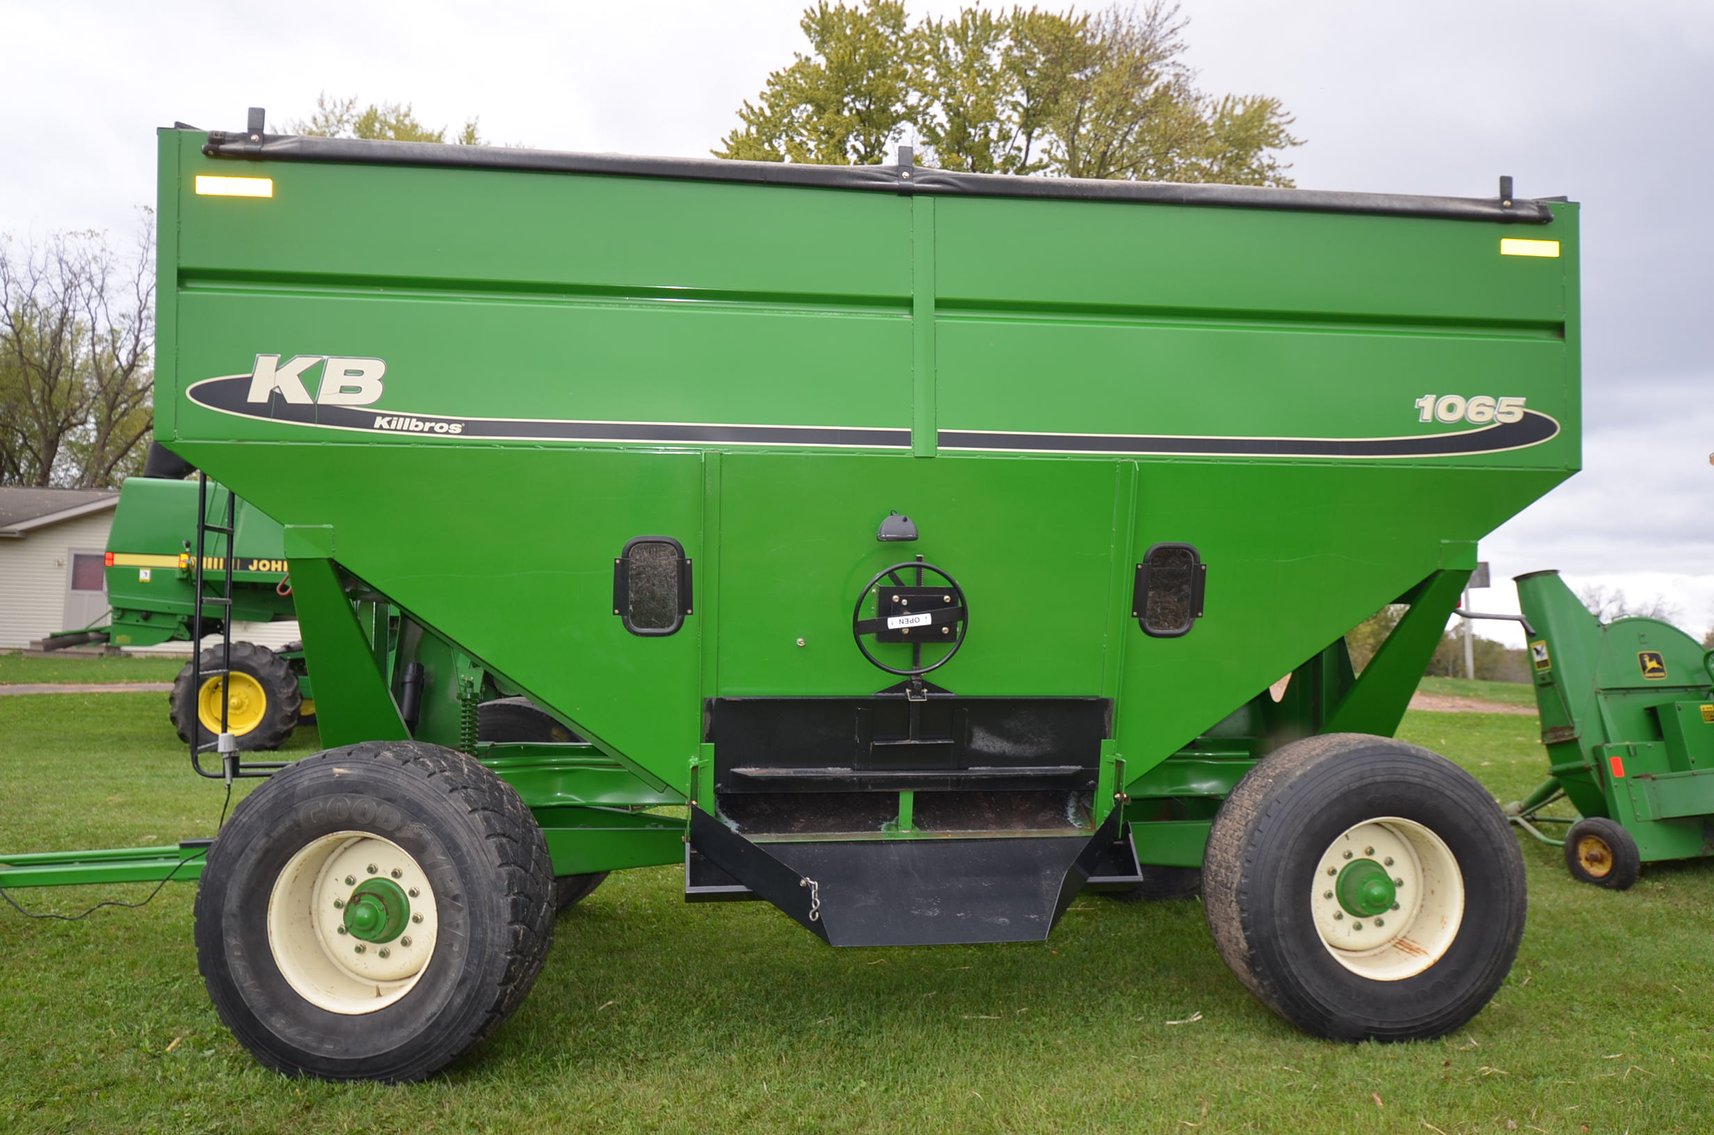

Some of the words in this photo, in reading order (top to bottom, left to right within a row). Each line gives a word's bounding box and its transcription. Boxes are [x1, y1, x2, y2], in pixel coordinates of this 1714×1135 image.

[247, 353, 387, 405] KB
[1415, 394, 1527, 424] 1065
[373, 415, 463, 434] Killbros
[898, 616, 920, 625] OPEN
